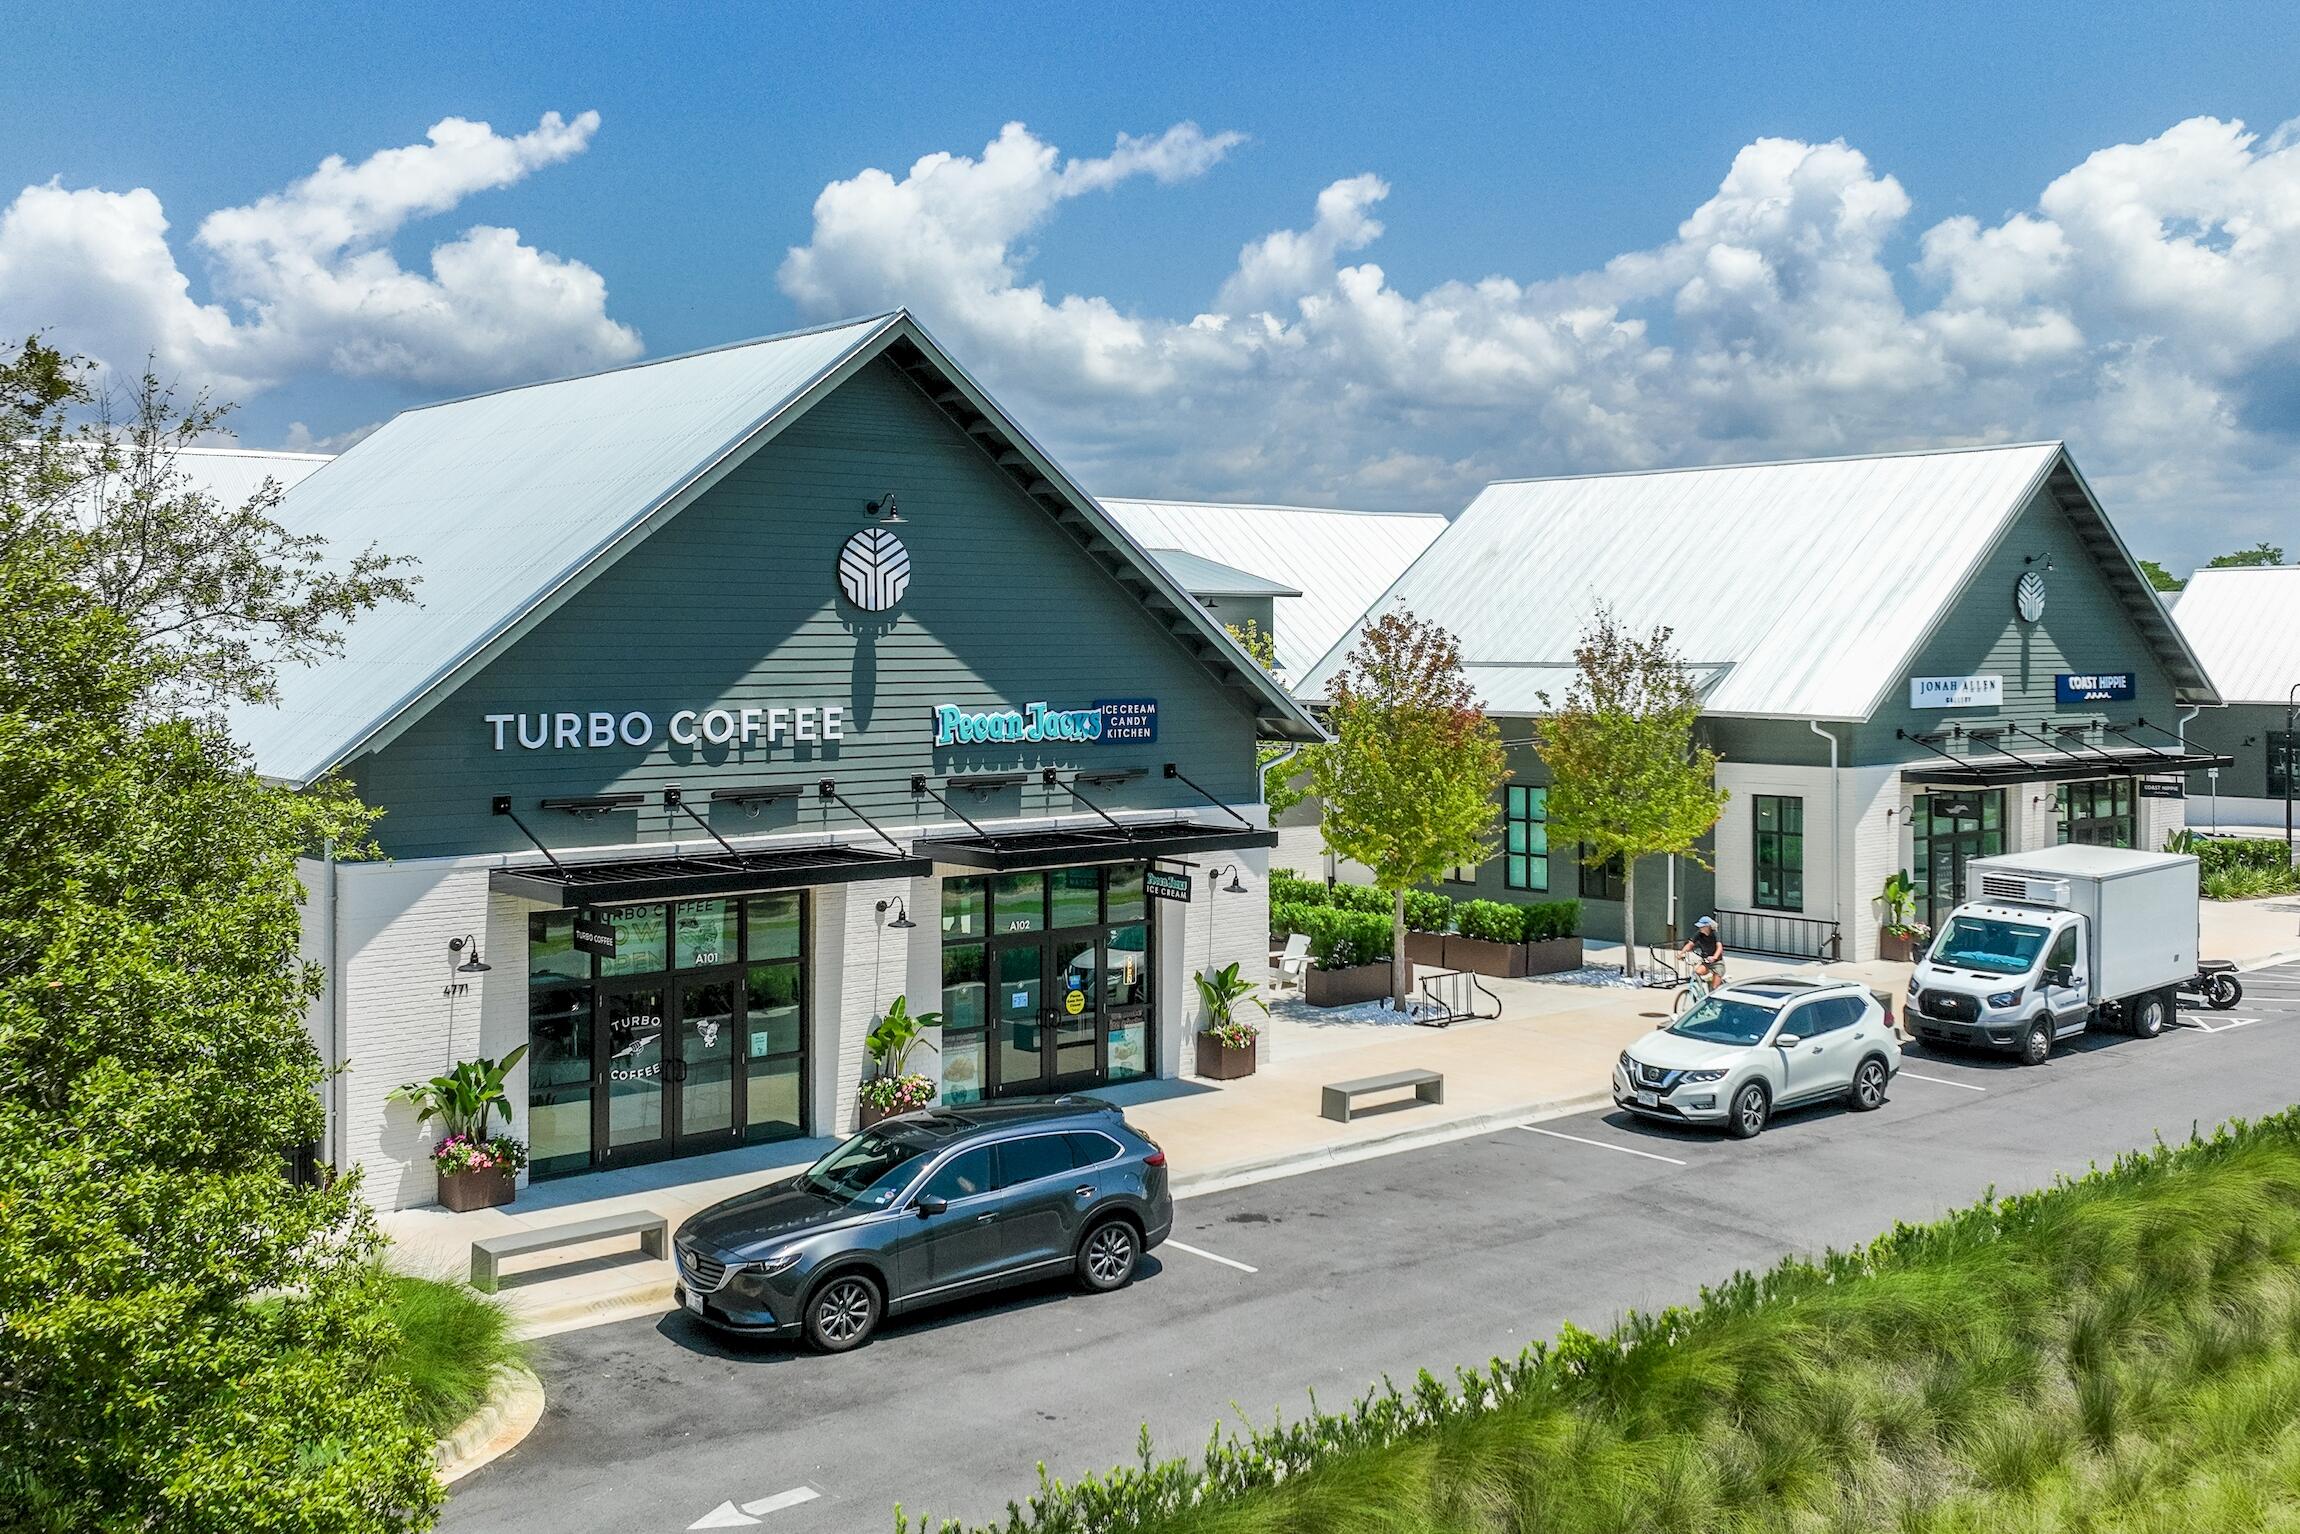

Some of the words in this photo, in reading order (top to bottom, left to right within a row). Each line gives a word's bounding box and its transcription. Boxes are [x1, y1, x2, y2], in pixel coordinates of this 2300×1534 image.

[1920, 681, 1958, 695] JONAH
[1962, 680, 1996, 692] ALLEN
[2069, 676, 2097, 690] COAST
[2099, 675, 2127, 689] HIPPIE
[1102, 705, 1118, 715] ICE
[1120, 704, 1156, 714] CREAM
[485, 711, 653, 750] TURBO
[669, 706, 845, 745] COFFEE
[936, 704, 1025, 747] Pecan
[1025, 701, 1102, 743] Jacks
[1110, 716, 1147, 726] CANDY
[1107, 728, 1151, 738] KITCHEN
[1146, 885, 1159, 895] ICE
[1161, 887, 1187, 899] CREAM
[615, 920, 662, 946] OW
[1009, 920, 1031, 931] A102
[576, 930, 593, 942] TURBO
[593, 934, 613, 947] COFFEE
[695, 952, 718, 965] A101
[443, 983, 469, 998] 4771
[611, 1015, 661, 1031] TURBO
[611, 1063, 660, 1081] COFFEE
